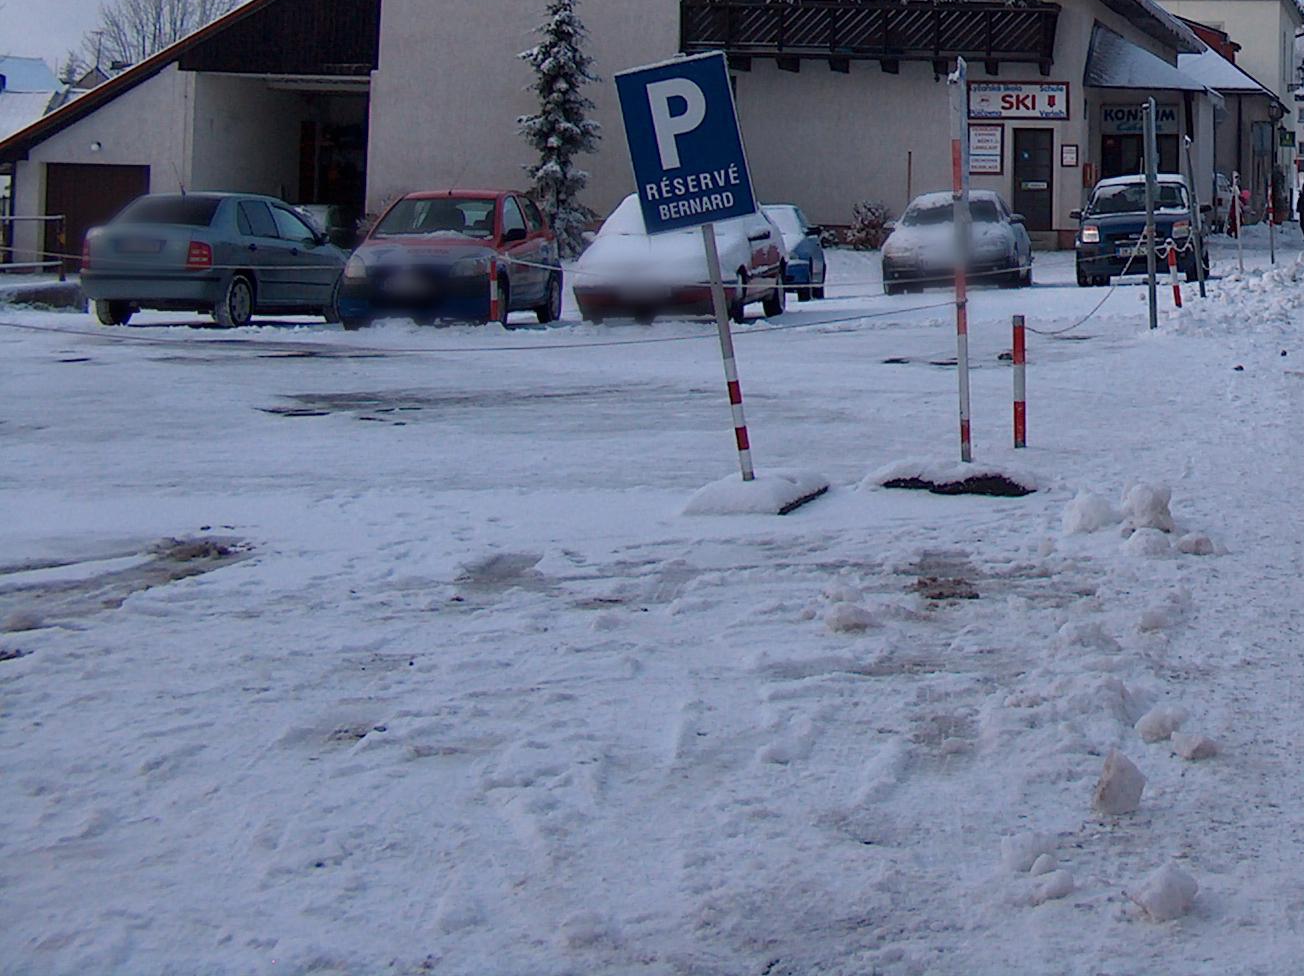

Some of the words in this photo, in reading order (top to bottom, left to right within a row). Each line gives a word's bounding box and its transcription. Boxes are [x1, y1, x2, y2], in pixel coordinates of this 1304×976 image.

[1001, 94, 1036, 111] SKI
[646, 77, 706, 171] P
[645, 163, 741, 201] RÉSERVÉ
[658, 191, 734, 221] BERNARD
